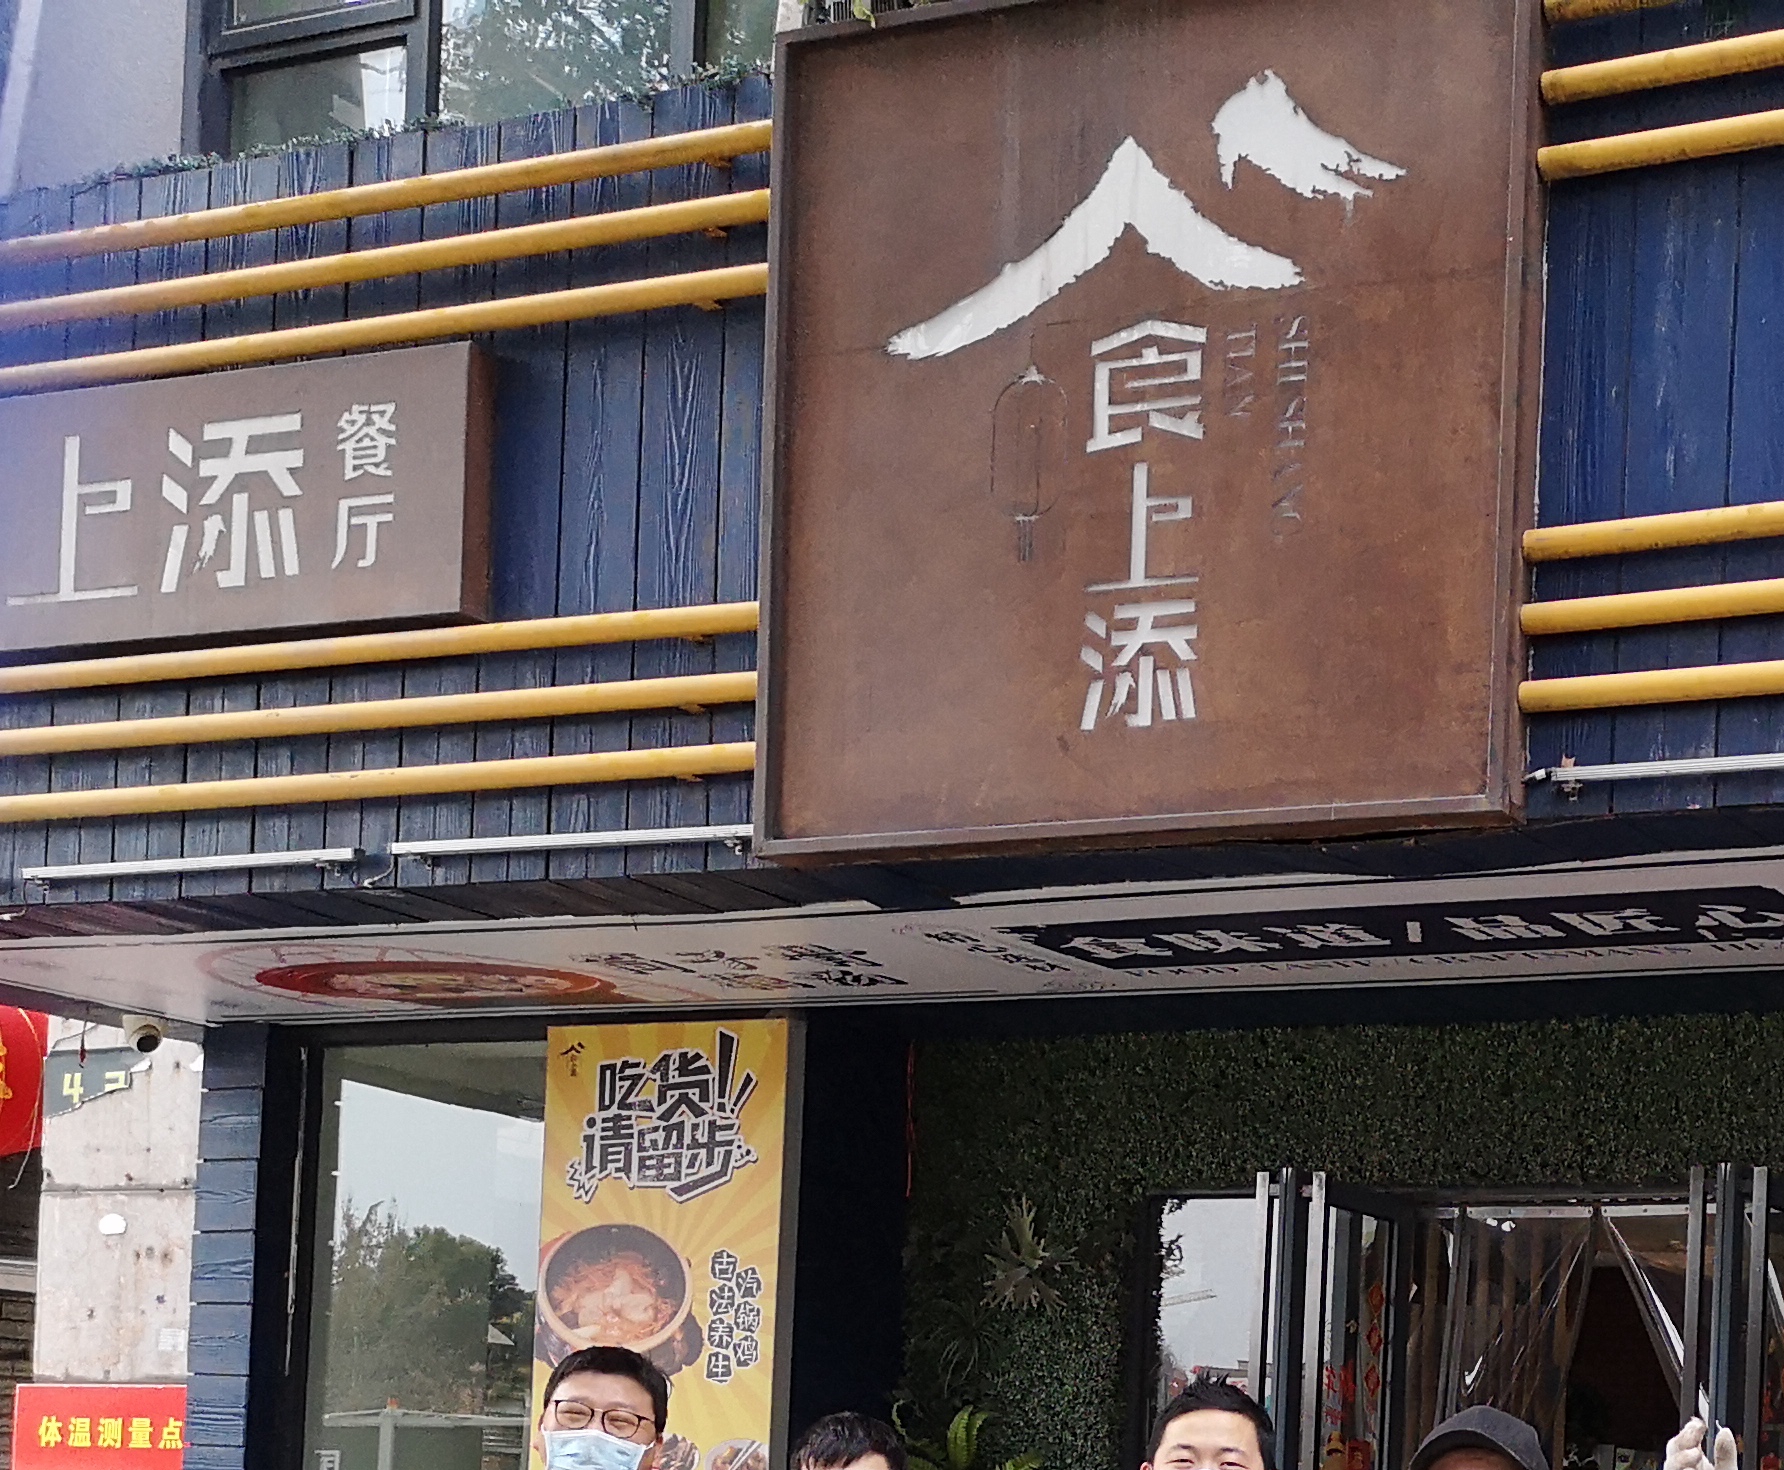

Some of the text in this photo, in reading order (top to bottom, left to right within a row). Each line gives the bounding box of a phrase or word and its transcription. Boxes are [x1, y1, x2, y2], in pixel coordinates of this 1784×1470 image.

[331, 402, 397, 569] 餐厅
[1080, 318, 1208, 732] 食上添
[582, 1112, 742, 1200] 请留步
[706, 1249, 738, 1383] 古法养生
[733, 1267, 762, 1367] 汽锅鸡
[38, 1415, 184, 1449] 体温测量点
